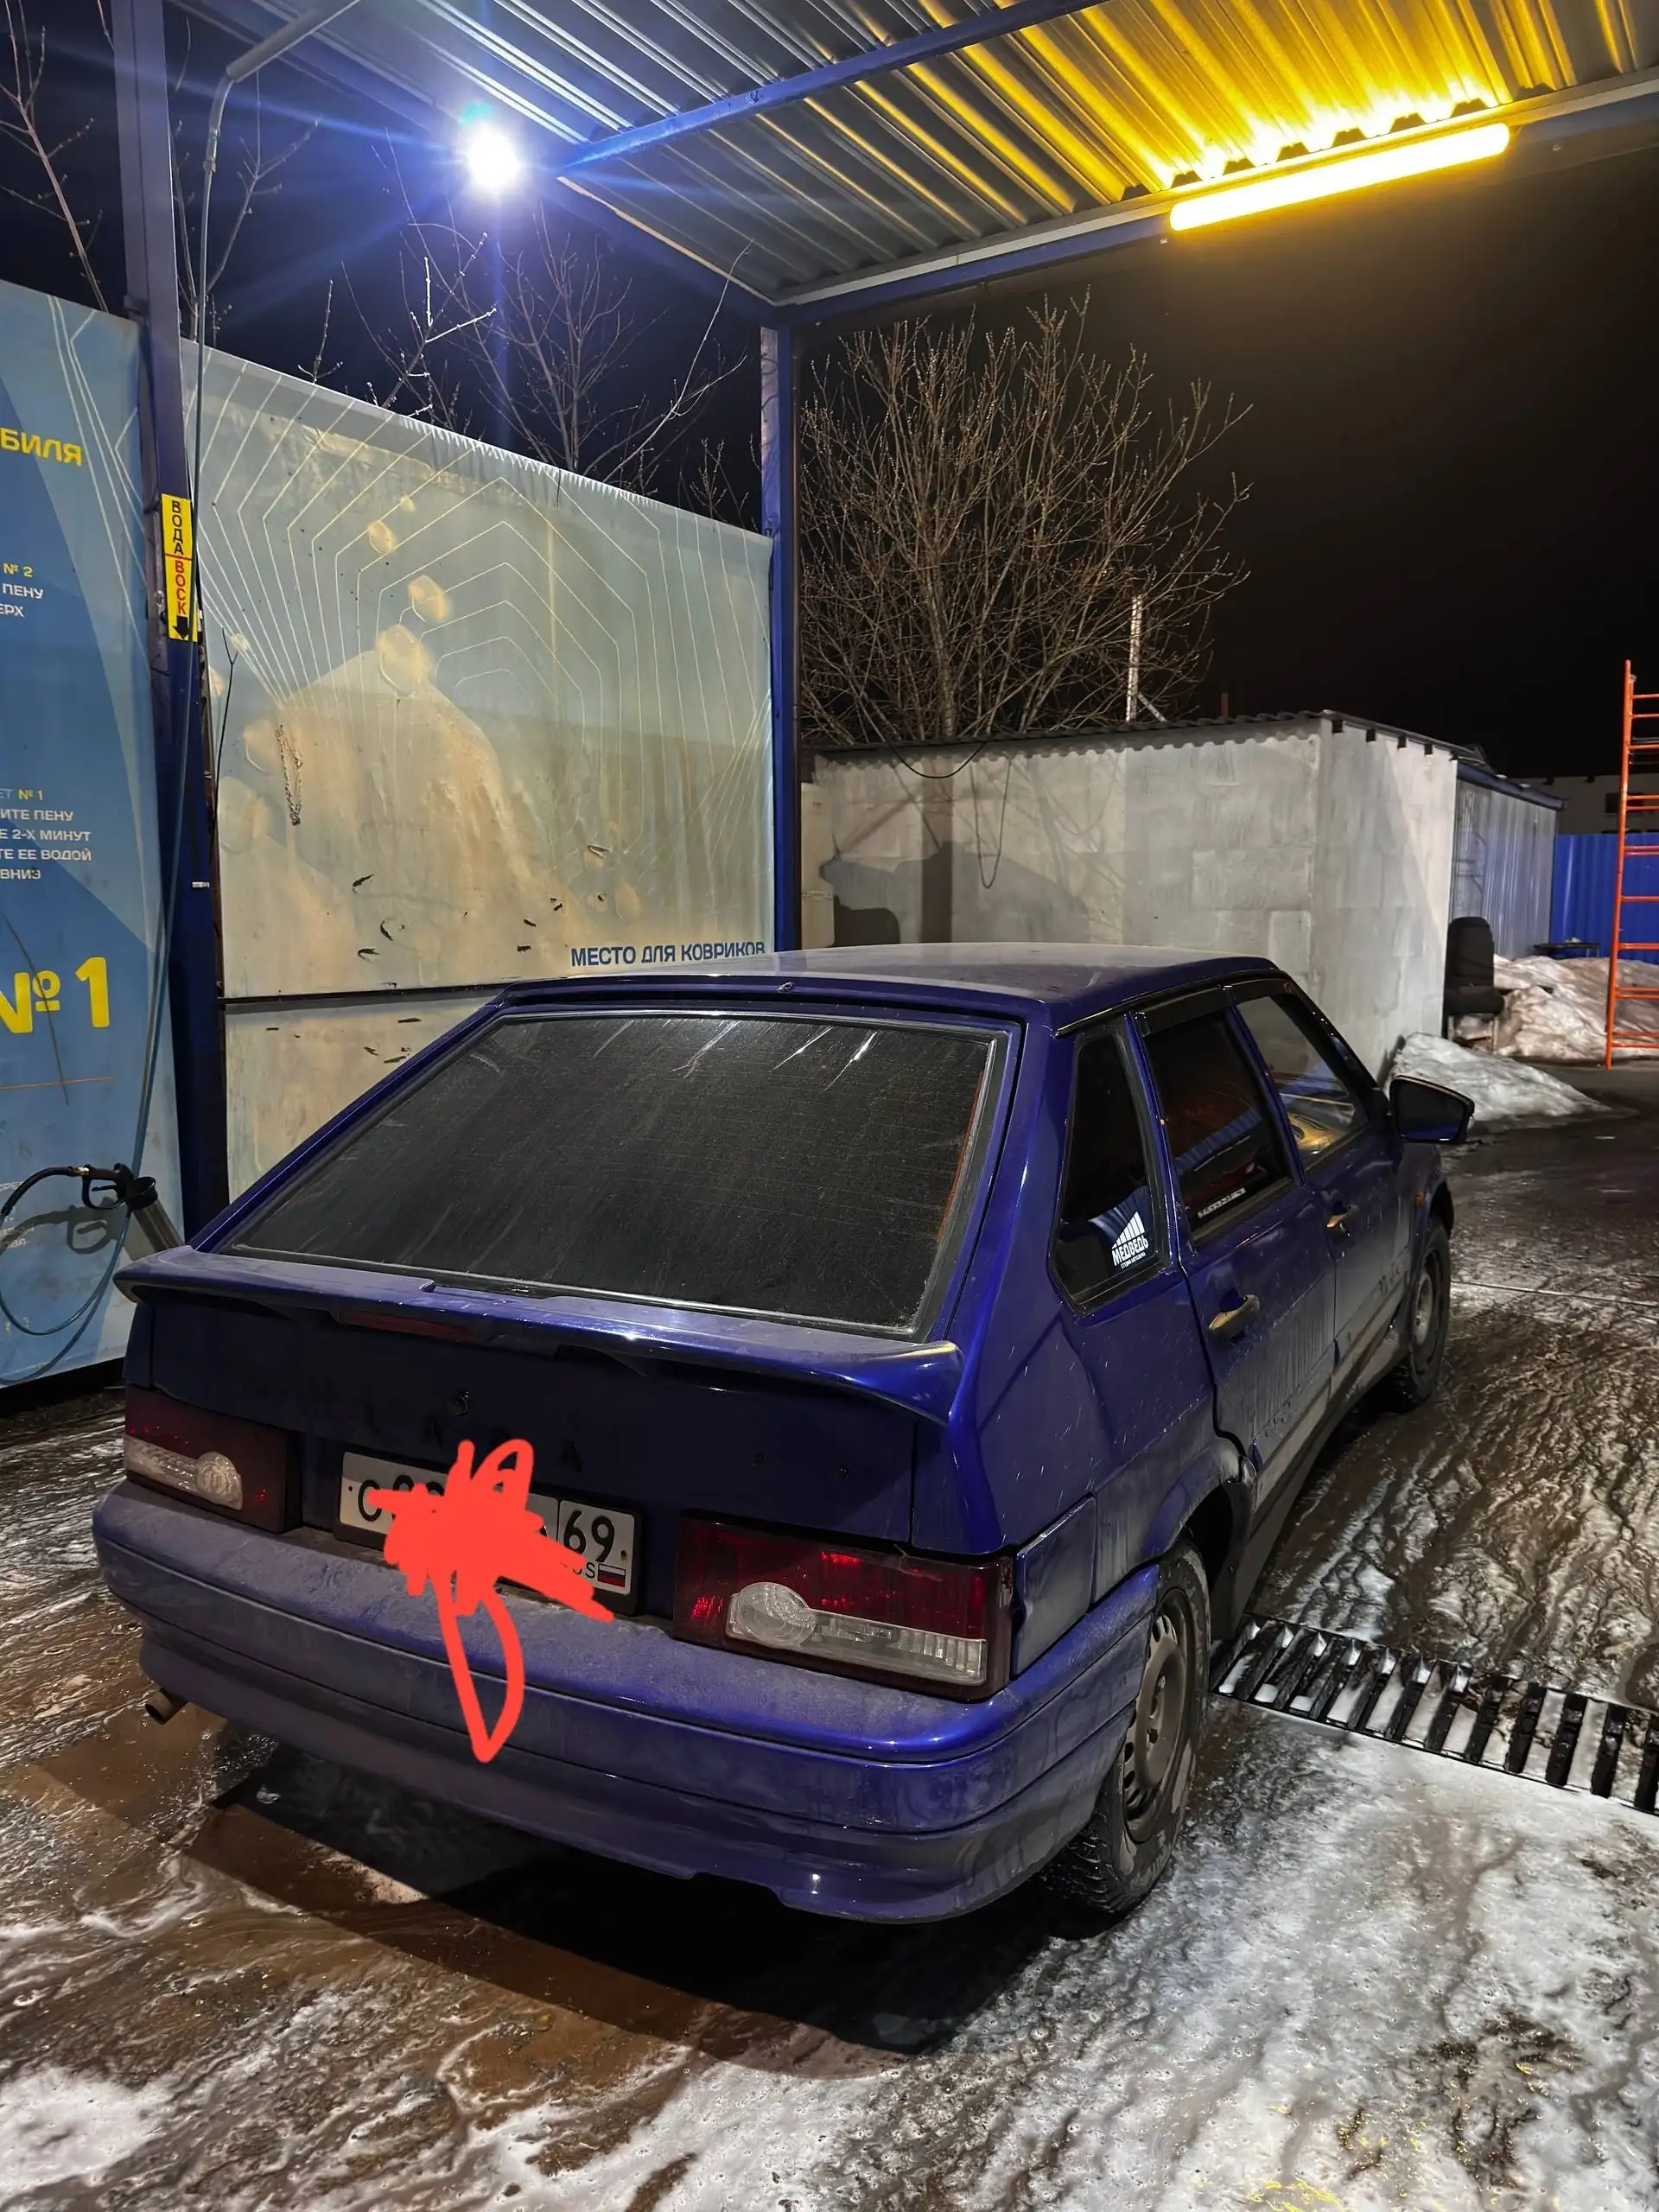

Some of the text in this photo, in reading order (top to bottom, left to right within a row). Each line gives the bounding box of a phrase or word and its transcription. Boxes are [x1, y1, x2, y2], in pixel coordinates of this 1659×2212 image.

[0, 427, 82, 467] БИЛЯ
[171, 499, 188, 616] ВОДА ВОСК
[23, 566, 34, 578] 2
[2, 582, 44, 599] ПЕНУ
[37, 789, 43, 801] 1
[34, 810, 73, 822] ПЕНУ
[12, 829, 35, 840] 2-Х
[40, 830, 92, 842] МИНУТ
[18, 849, 37, 860] ЕЕ
[41, 847, 92, 861] ВОДОЙ
[0, 868, 41, 880] ВНИЗ
[571, 941, 766, 967] МЕСТО ДЛЯ КОВРИКОВ
[74, 956, 111, 1029] 1
[1111, 1235, 1149, 1267] МЕДВЕДЬ
[563, 1510, 615, 1562] 69
